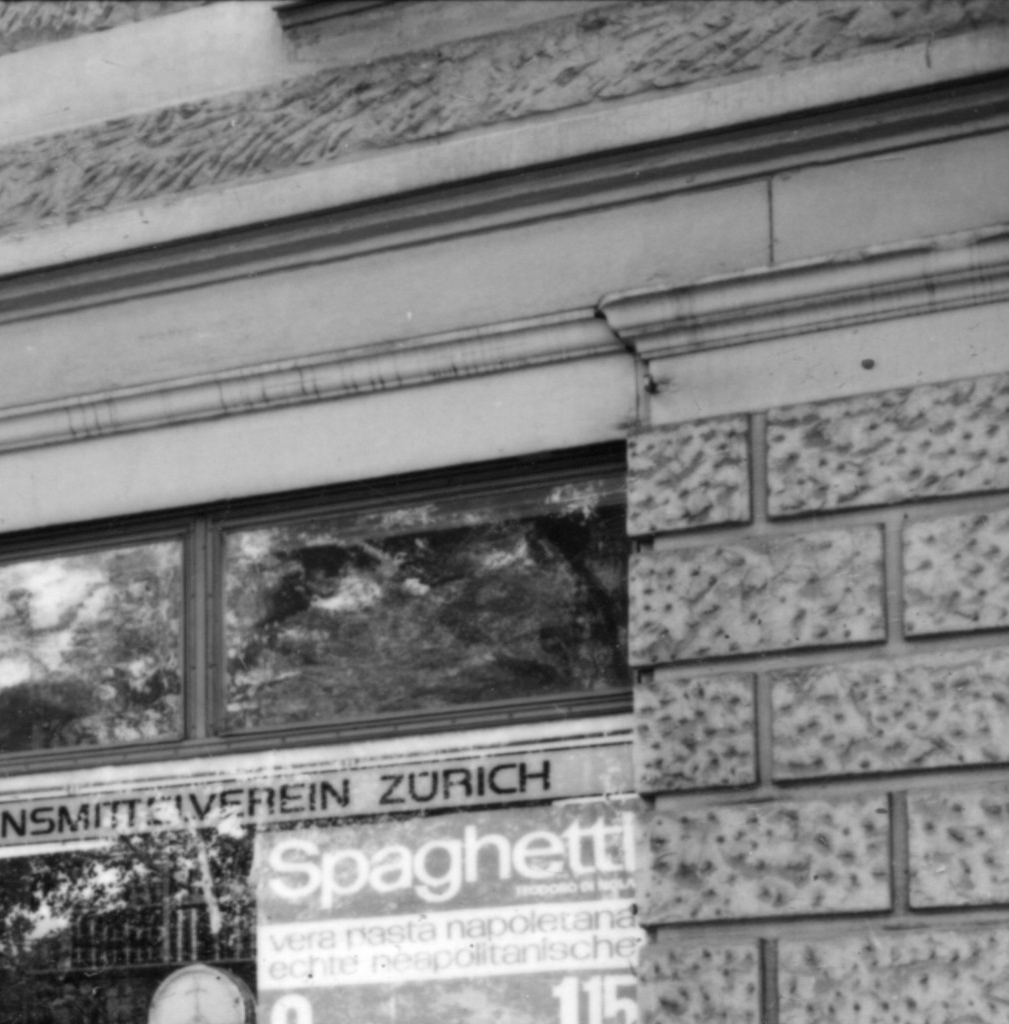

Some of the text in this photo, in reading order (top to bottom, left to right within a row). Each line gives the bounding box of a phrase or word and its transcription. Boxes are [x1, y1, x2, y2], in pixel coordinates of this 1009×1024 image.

[379, 760, 551, 806] ZÜRICH
[269, 811, 635, 910] Spaghetti
[270, 908, 637, 952] vera pasta napoletana
[269, 935, 638, 981] echte neapolitanische
